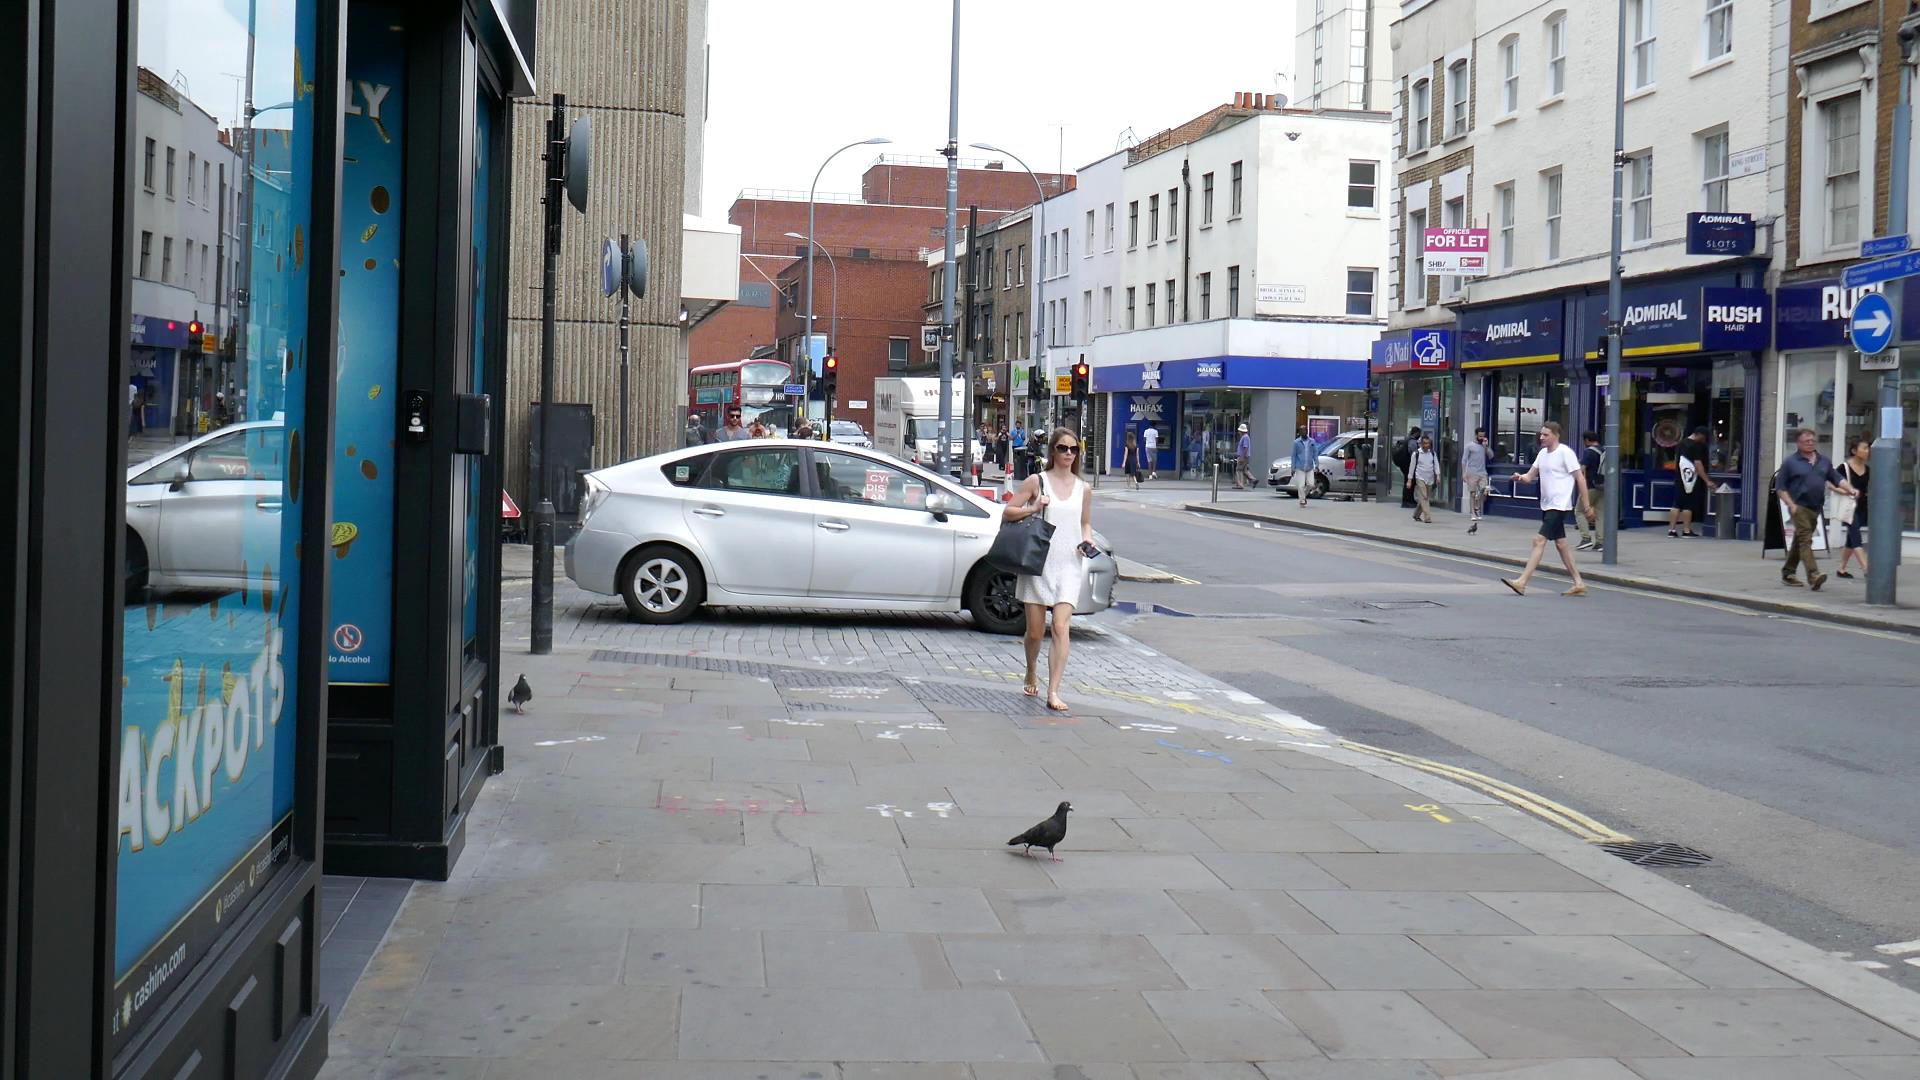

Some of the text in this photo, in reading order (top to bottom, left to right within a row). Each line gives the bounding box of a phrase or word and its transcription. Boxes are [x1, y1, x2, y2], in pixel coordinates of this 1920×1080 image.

[345, 80, 391, 119] LY
[1698, 214, 1746, 225] ADMIRAL
[1426, 235, 1487, 248] FOR LET
[1706, 240, 1737, 248] SLOTS
[1623, 299, 1688, 327] ADMIRAL
[1707, 305, 1762, 323] RUSH
[1485, 319, 1532, 342] ADMIRAL
[1724, 324, 1745, 332] HAIR
[924, 389, 962, 397] HUT
[1130, 403, 1163, 413] HALIFAX
[338, 655, 371, 664] Alcohol
[117, 627, 285, 854] ACKPOTS
[133, 942, 186, 1012] cashino.com
